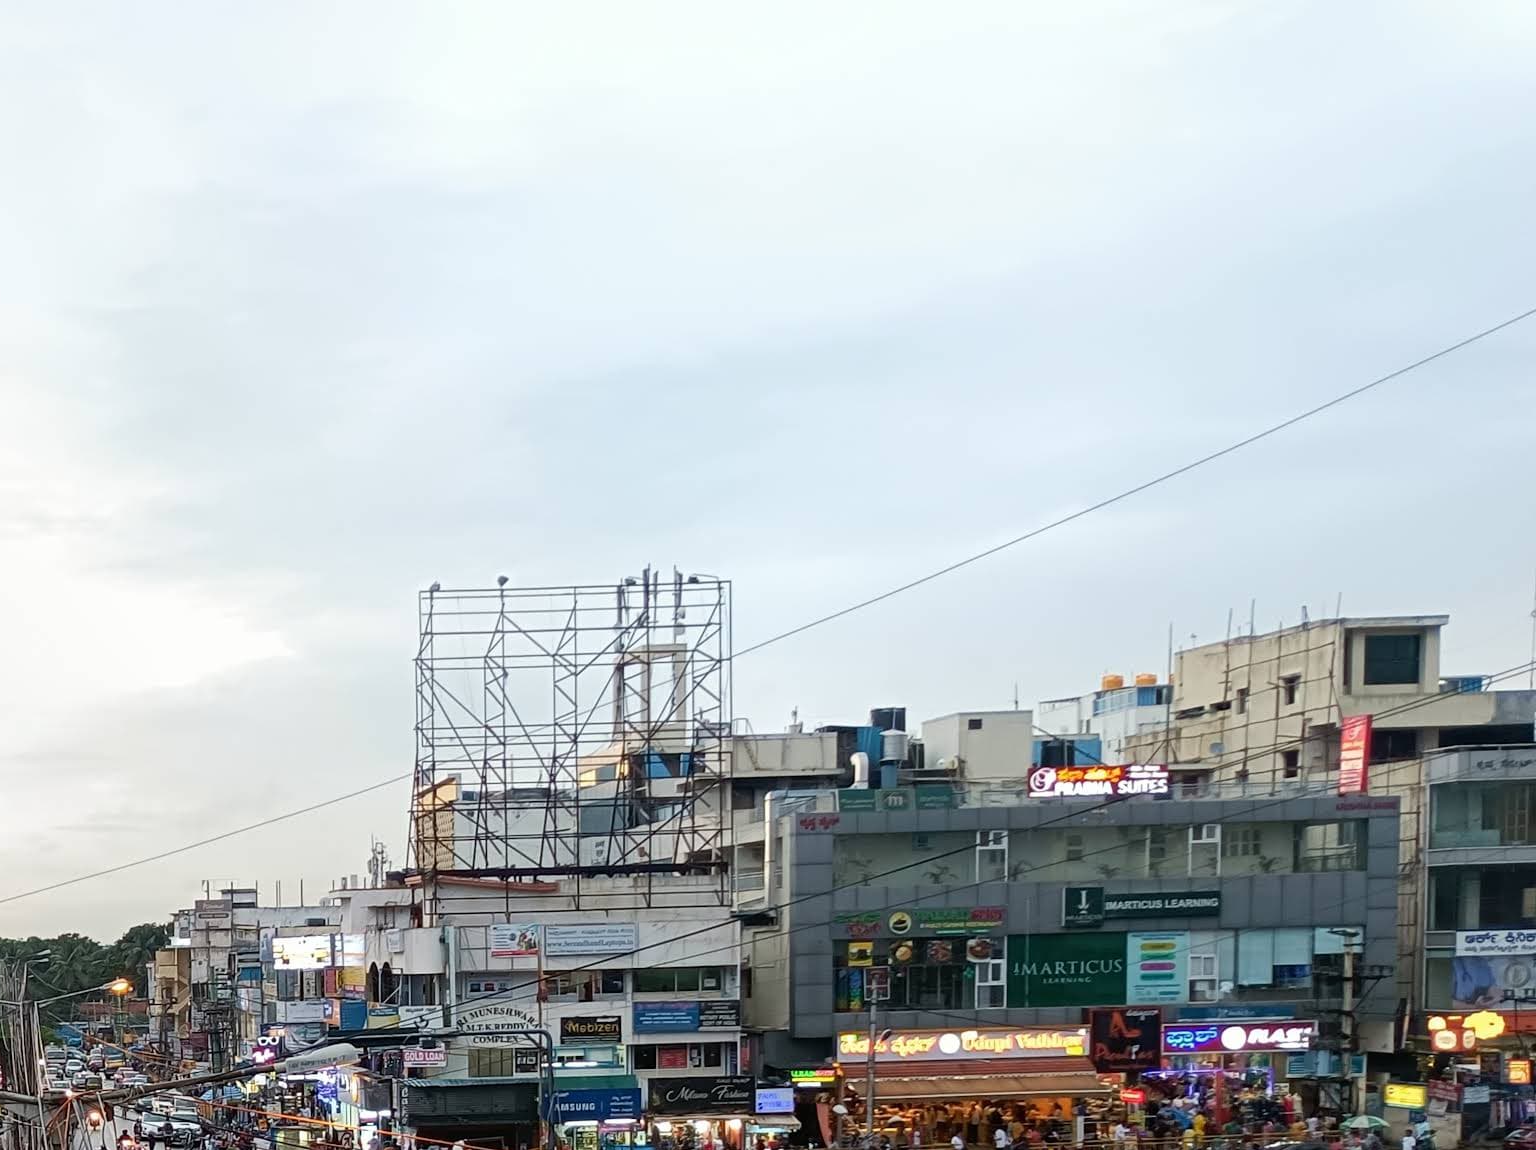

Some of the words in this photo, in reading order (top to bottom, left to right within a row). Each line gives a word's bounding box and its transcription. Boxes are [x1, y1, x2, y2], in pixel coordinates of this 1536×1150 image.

[1117, 779, 1168, 794] SUITES
[1105, 900, 1163, 911] IMARTICUS
[1165, 898, 1218, 909] LEARNING
[1013, 959, 1123, 976] IMARTICUS
[473, 1035, 519, 1044] COMPLEX
[404, 1052, 424, 1061] GOLD
[425, 1052, 444, 1061] LOAN
[553, 1102, 596, 1112] AMSUNG
